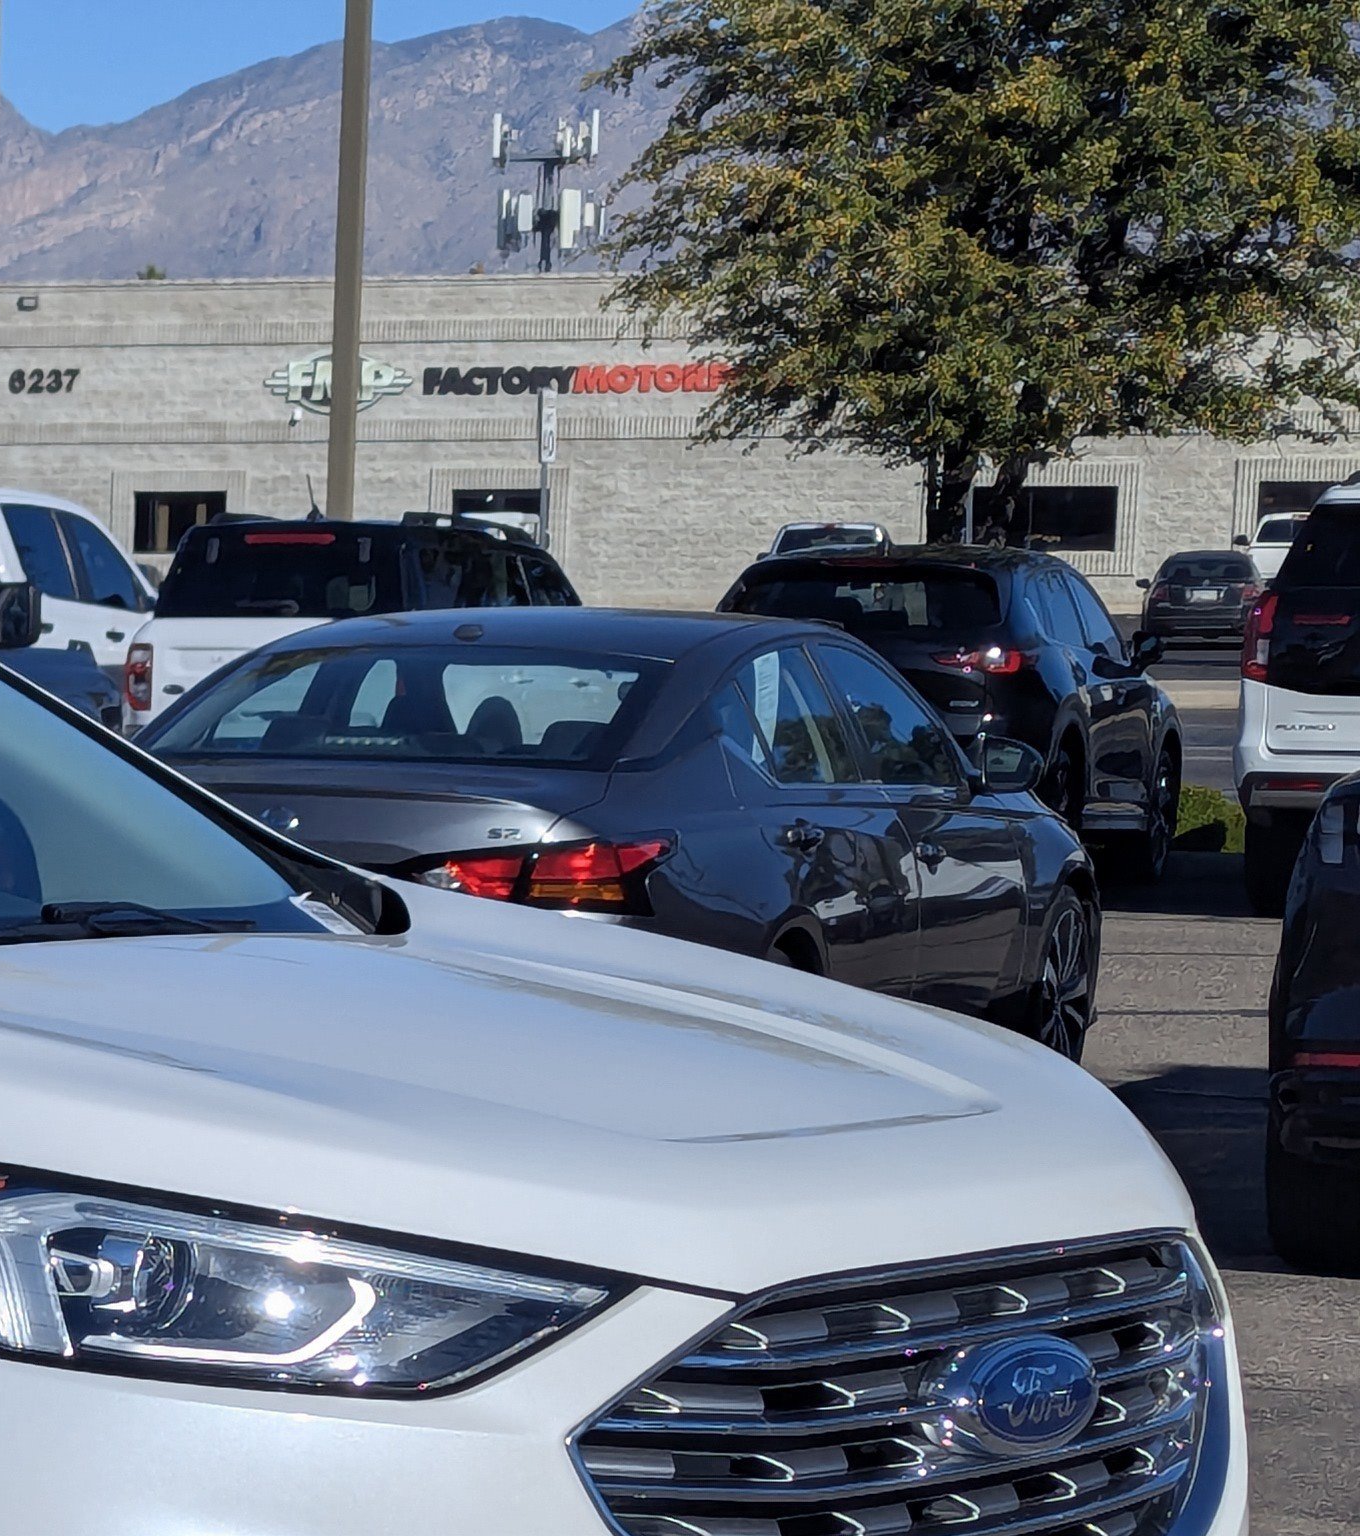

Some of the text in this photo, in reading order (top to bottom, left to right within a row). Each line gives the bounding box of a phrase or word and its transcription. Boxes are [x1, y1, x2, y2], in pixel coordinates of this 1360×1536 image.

[8, 368, 80, 394] 6237
[422, 365, 576, 395] FACTORY
[998, 1364, 1077, 1428] Ford
